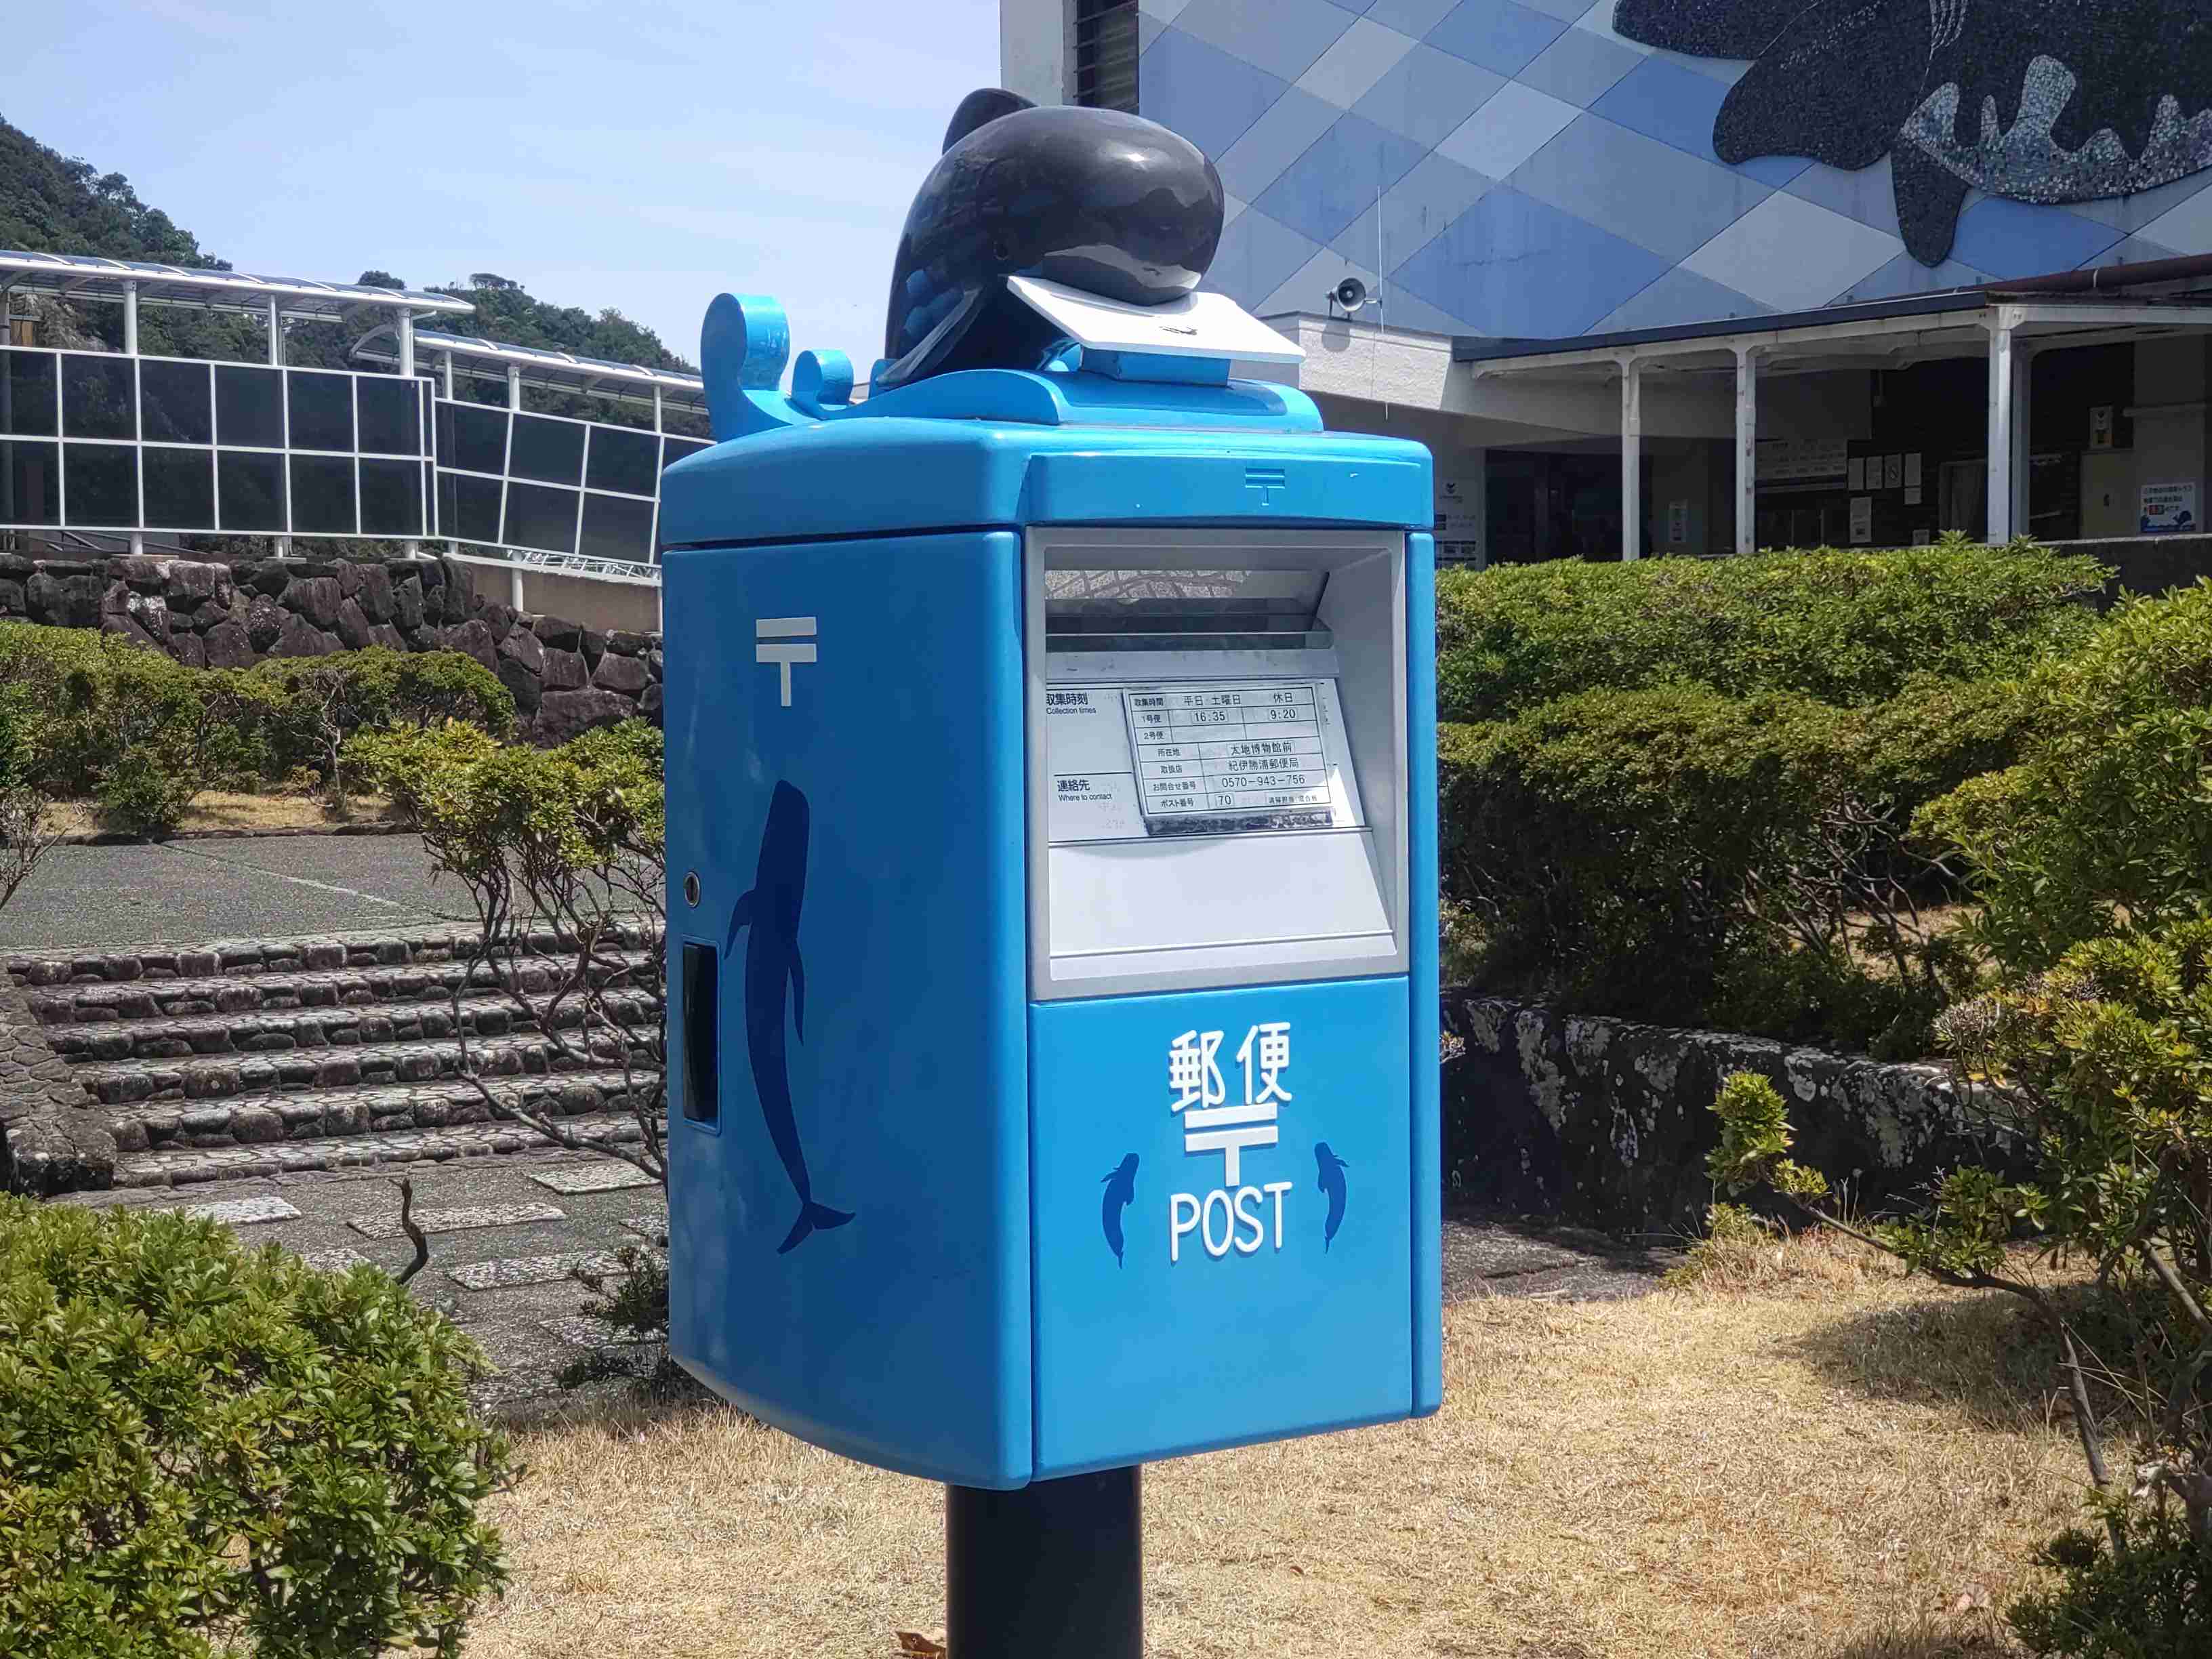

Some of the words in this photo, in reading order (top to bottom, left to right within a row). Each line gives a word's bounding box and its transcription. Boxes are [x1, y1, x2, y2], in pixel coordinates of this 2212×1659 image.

[1046, 692, 1088, 705] 取集時刻
[1273, 693, 1293, 703] 休日
[1194, 711, 1225, 722] 16:35
[1270, 709, 1296, 720] 9:20
[1144, 731, 1164, 740] 2号便
[1158, 747, 1181, 757] 所在地
[1160, 764, 1183, 774] 取扱店
[1228, 758, 1299, 772] 紀伊勝浦郵便局
[1057, 779, 1090, 792] 連絡先
[1153, 781, 1197, 792] お問合せ番号
[1160, 798, 1195, 808] ポスト番号
[1218, 796, 1232, 806] 70
[1168, 1021, 1293, 1113] 郵便
[1170, 1181, 1293, 1262] POST
